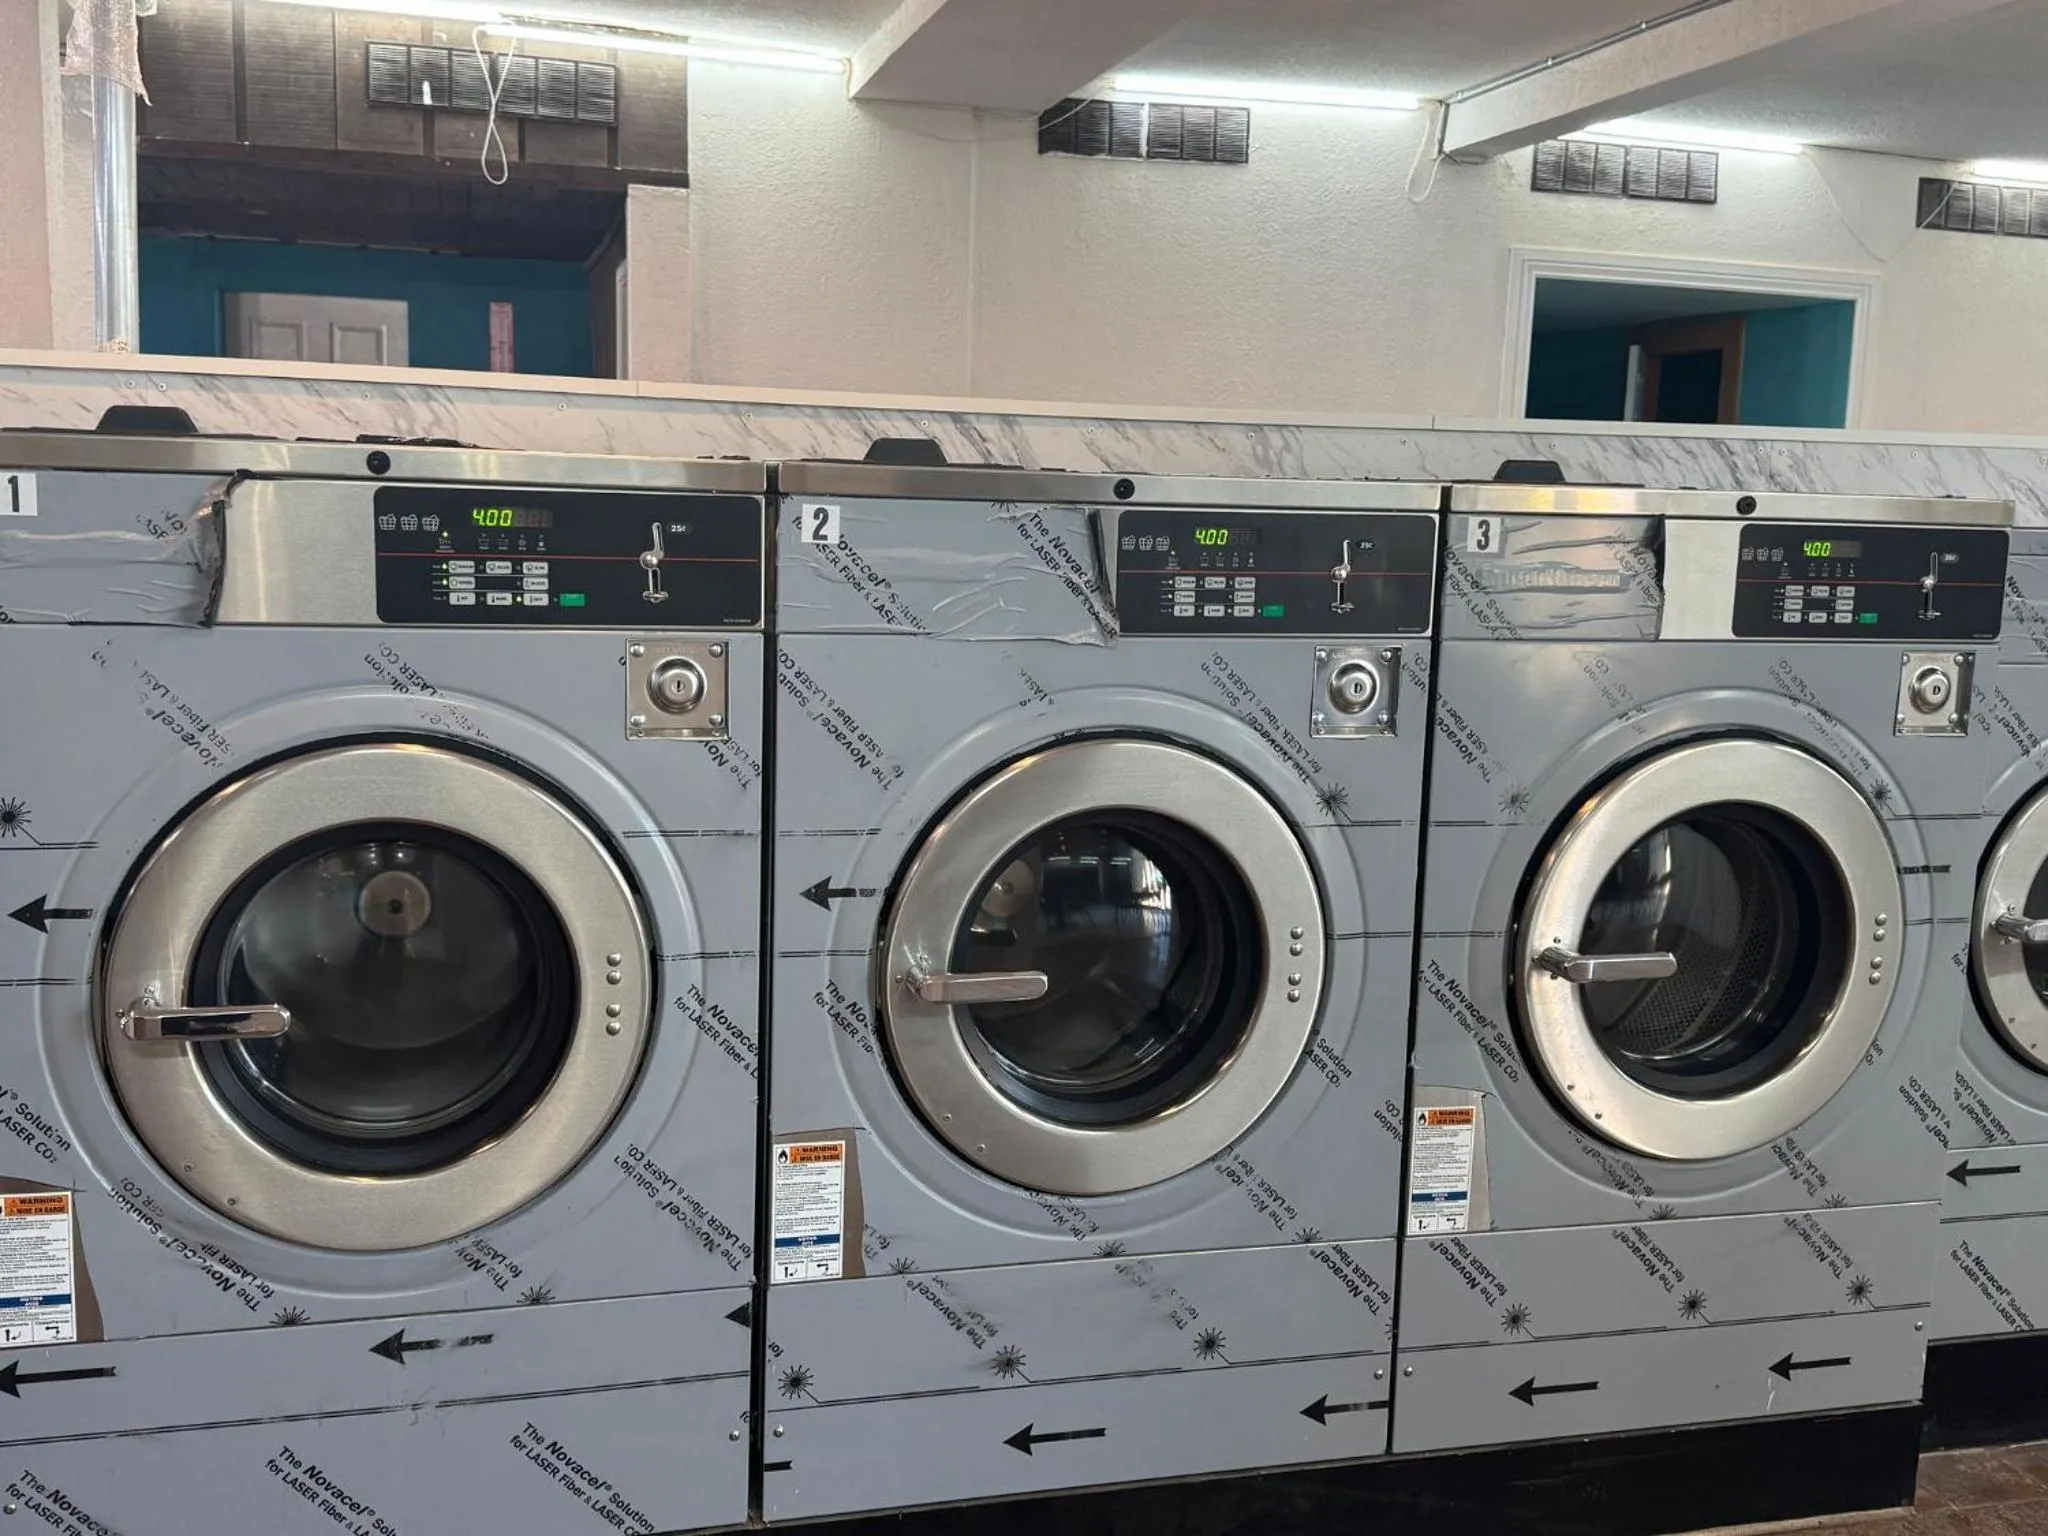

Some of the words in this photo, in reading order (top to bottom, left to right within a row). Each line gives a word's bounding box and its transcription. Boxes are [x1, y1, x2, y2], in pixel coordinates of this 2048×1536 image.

[8, 475, 20, 513] 1
[472, 508, 513, 527] 4.00
[813, 507, 829, 541] 2
[1194, 528, 1228, 545] 4.00
[1477, 519, 1491, 551] 3
[1804, 541, 1832, 557] 4.00
[1228, 669, 1256, 702] LASER
[177, 703, 210, 732] Fiber
[831, 706, 859, 734] Fiber
[1446, 708, 1470, 733] Fiber
[1427, 960, 1445, 982] The
[687, 984, 706, 1007] The
[825, 980, 846, 1004] The
[827, 1005, 860, 1040] LASER
[1428, 982, 1456, 1014] LASER
[1454, 1010, 1474, 1034] Fiber
[1477, 1036, 1506, 1069] LASER
[688, 1010, 720, 1041] LASER
[719, 1039, 746, 1063] Fiber
[1317, 1038, 1352, 1078] Solution
[1325, 1069, 1341, 1088] CO2
[1898, 1085, 1929, 1123] Solution
[1918, 1086, 1942, 1117] LASER
[15, 1102, 71, 1152] Solution
[1990, 1115, 2010, 1140] LASER
[35, 1141, 58, 1163] CO2
[121, 1176, 142, 1198] CO2
[643, 1158, 677, 1190] LASER
[19, 1196, 63, 1205] WARNING
[1256, 1178, 1287, 1208] LASER
[108, 1187, 162, 1235] Solution
[1269, 1209, 1286, 1231] The
[1286, 1206, 1298, 1221] for
[706, 1214, 741, 1248] LASER
[721, 1247, 742, 1273] The
[1332, 1243, 1356, 1270] Fiber
[1451, 1236, 1472, 1259] Fiber
[1649, 1246, 1673, 1272] LASER
[1959, 1239, 1973, 1258] The
[218, 1255, 258, 1285] LASER
[503, 1260, 523, 1279] for
[1309, 1249, 1363, 1299] Novacel®
[1428, 1240, 1481, 1290] Novacel®
[1470, 1257, 1497, 1285] LASER
[256, 1282, 276, 1300] for
[1353, 1265, 1380, 1293] LASER
[1494, 1281, 1508, 1297] for
[1658, 1273, 1675, 1294] The
[237, 1287, 260, 1312] The
[1377, 1289, 1391, 1305] for
[1479, 1285, 1497, 1307] The
[1959, 1260, 1981, 1284] LASER
[1996, 1302, 2017, 1327] LASER
[967, 1324, 987, 1350] The
[19, 1468, 46, 1494] The
[278, 1446, 303, 1470] The
[303, 1464, 377, 1516] Novacel®
[510, 1435, 528, 1451] for
[525, 1448, 560, 1479] LASER
[558, 1473, 586, 1500] Fiber
[583, 1495, 592, 1505] &
[591, 1499, 625, 1530] LASER
[523, 1421, 546, 1446] The
[546, 1440, 613, 1491] Novacel®
[609, 1492, 655, 1533] Solution
[265, 1458, 285, 1477] for
[281, 1472, 320, 1504] LASER
[318, 1499, 348, 1525] Fiber
[5, 1483, 26, 1502] for
[24, 1494, 64, 1529] LASER
